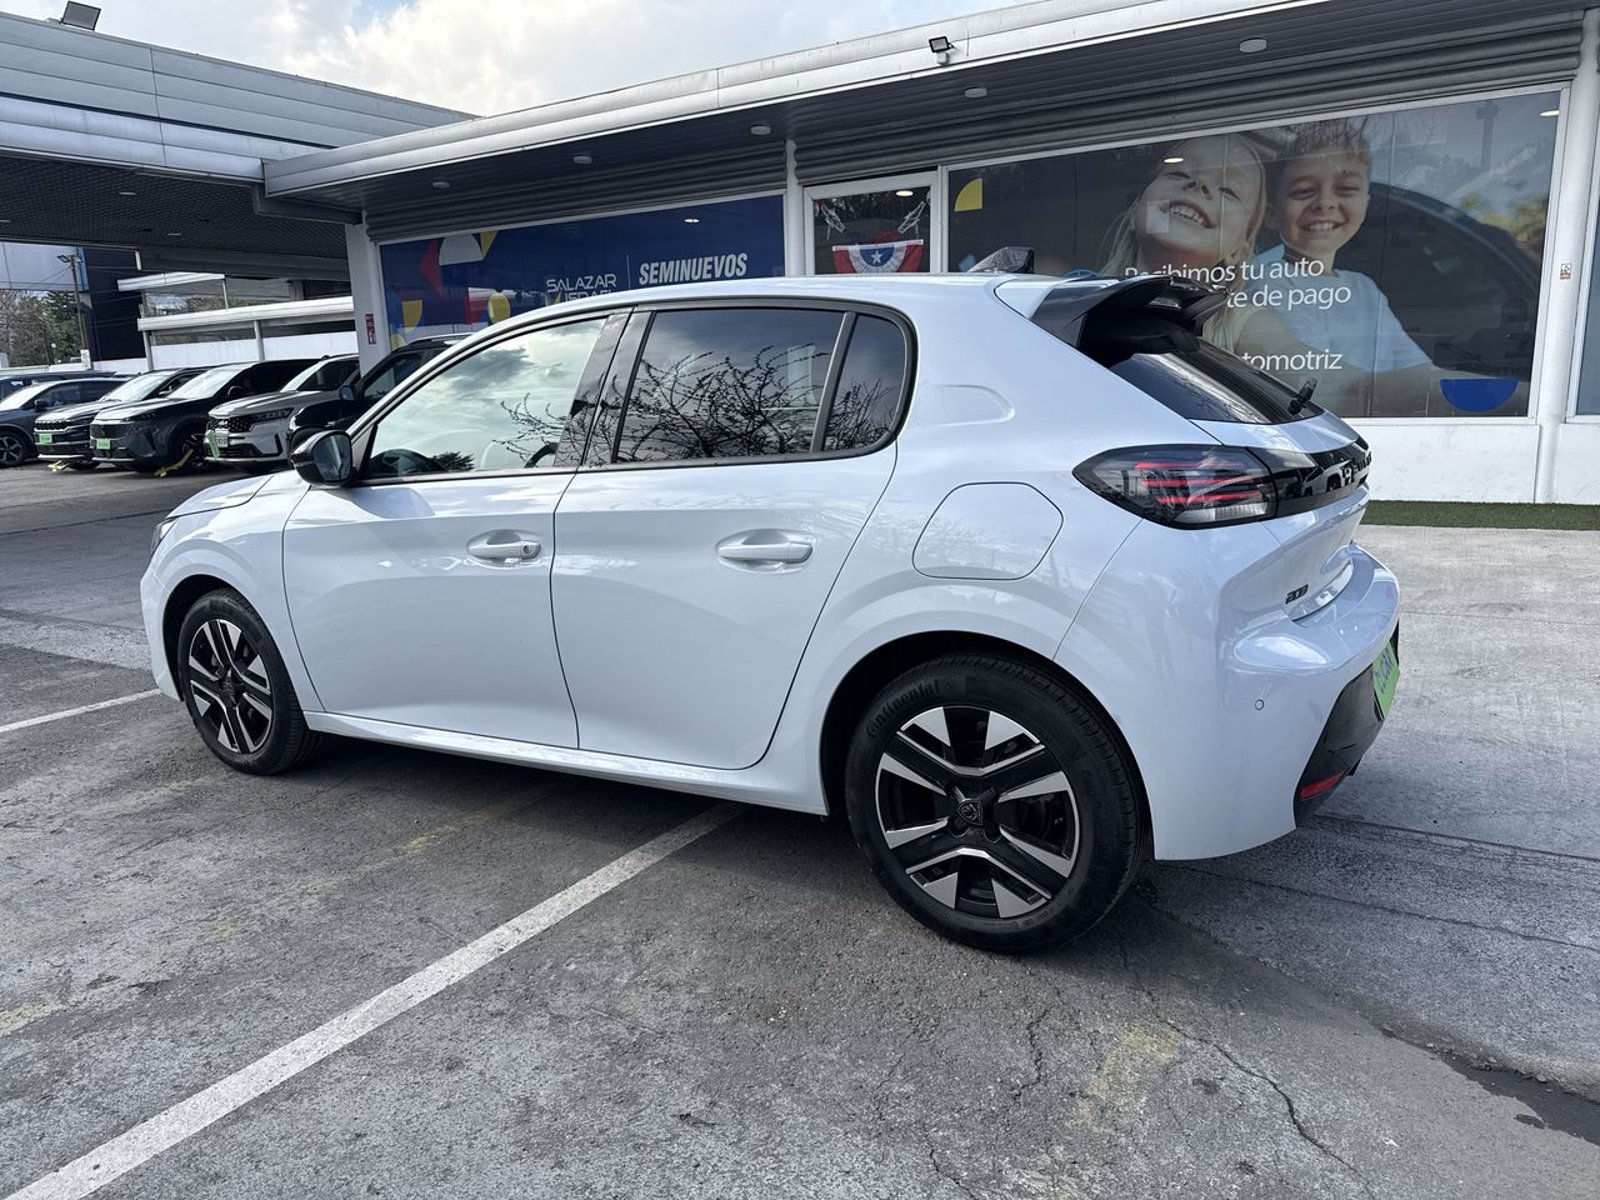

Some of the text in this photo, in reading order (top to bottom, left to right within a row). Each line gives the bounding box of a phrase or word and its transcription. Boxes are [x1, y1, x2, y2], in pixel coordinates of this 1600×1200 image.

[639, 253, 748, 285] SEMINUEVOS
[1240, 261, 1264, 280] tu
[1269, 257, 1325, 278] auto
[546, 273, 617, 293] SALAZAR
[1252, 284, 1283, 307] de
[1288, 286, 1352, 311] pago
